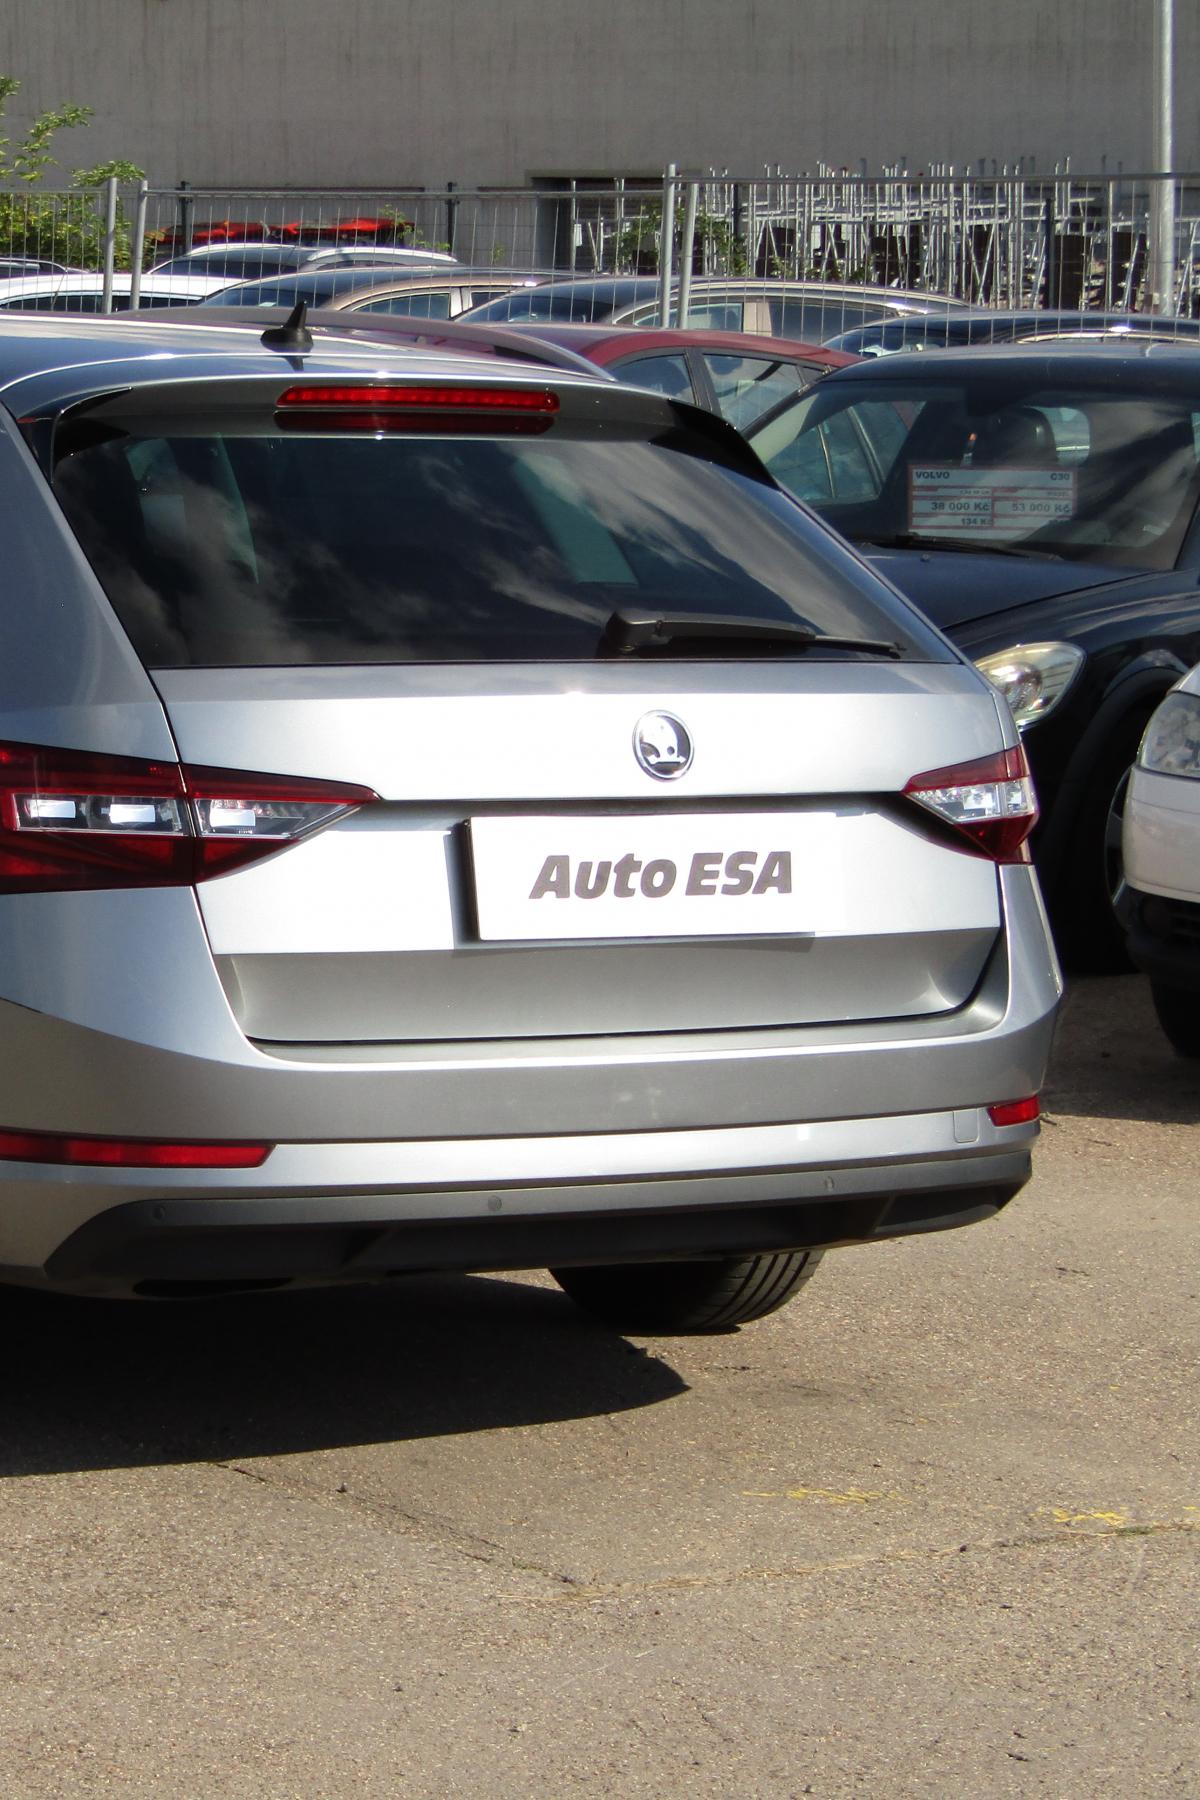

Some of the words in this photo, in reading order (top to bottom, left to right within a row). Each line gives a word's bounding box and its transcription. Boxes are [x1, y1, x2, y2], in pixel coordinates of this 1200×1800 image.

[915, 471, 950, 480] VOLVO
[949, 502, 970, 511] 000
[528, 853, 677, 900] Auto
[685, 851, 792, 896] ESA
